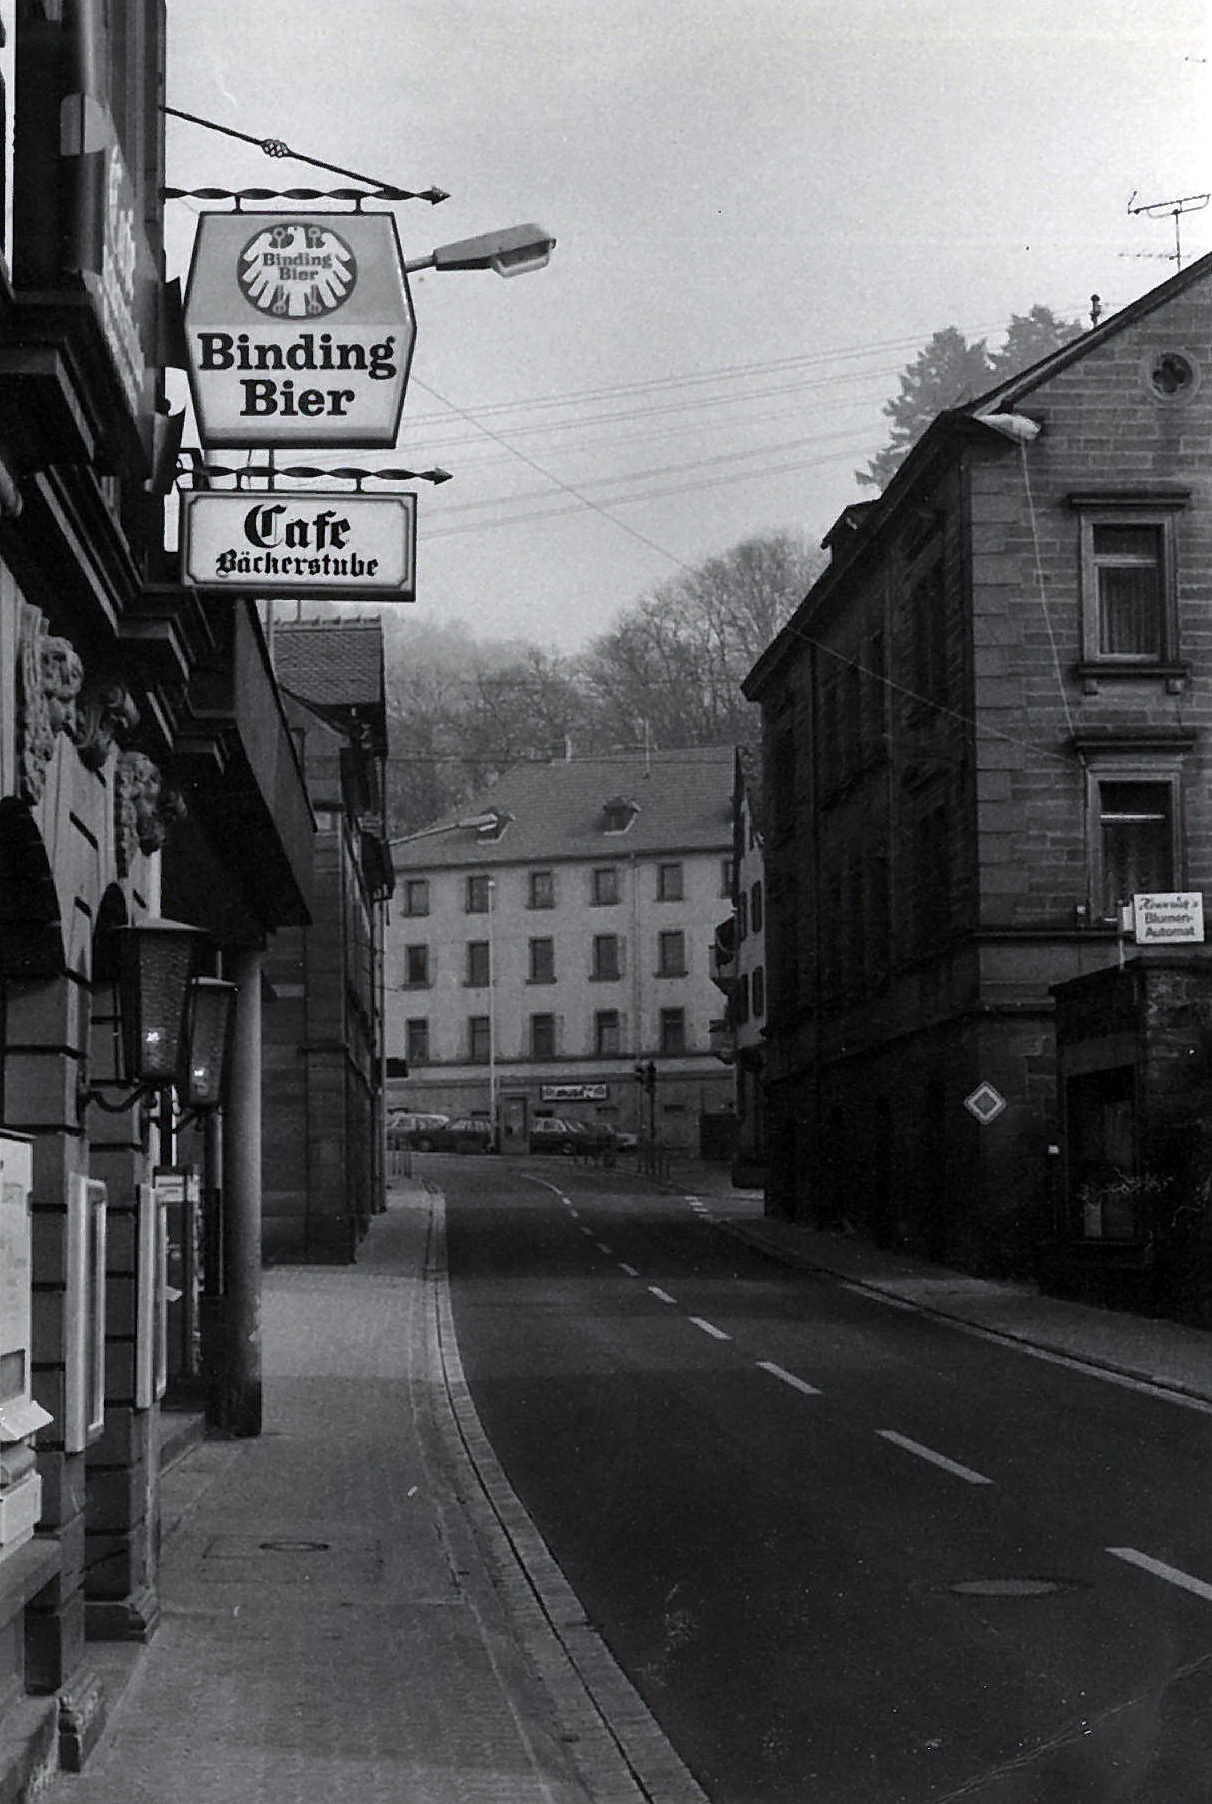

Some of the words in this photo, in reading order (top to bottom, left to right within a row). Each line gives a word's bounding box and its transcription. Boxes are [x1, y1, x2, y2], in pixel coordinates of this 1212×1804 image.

[263, 252, 332, 269] Binding
[279, 267, 319, 281] Bier
[197, 332, 397, 380] Binding
[240, 379, 356, 417] Bier
[216, 550, 380, 577] Bäckerstube
[1145, 926, 1195, 937] Automat
